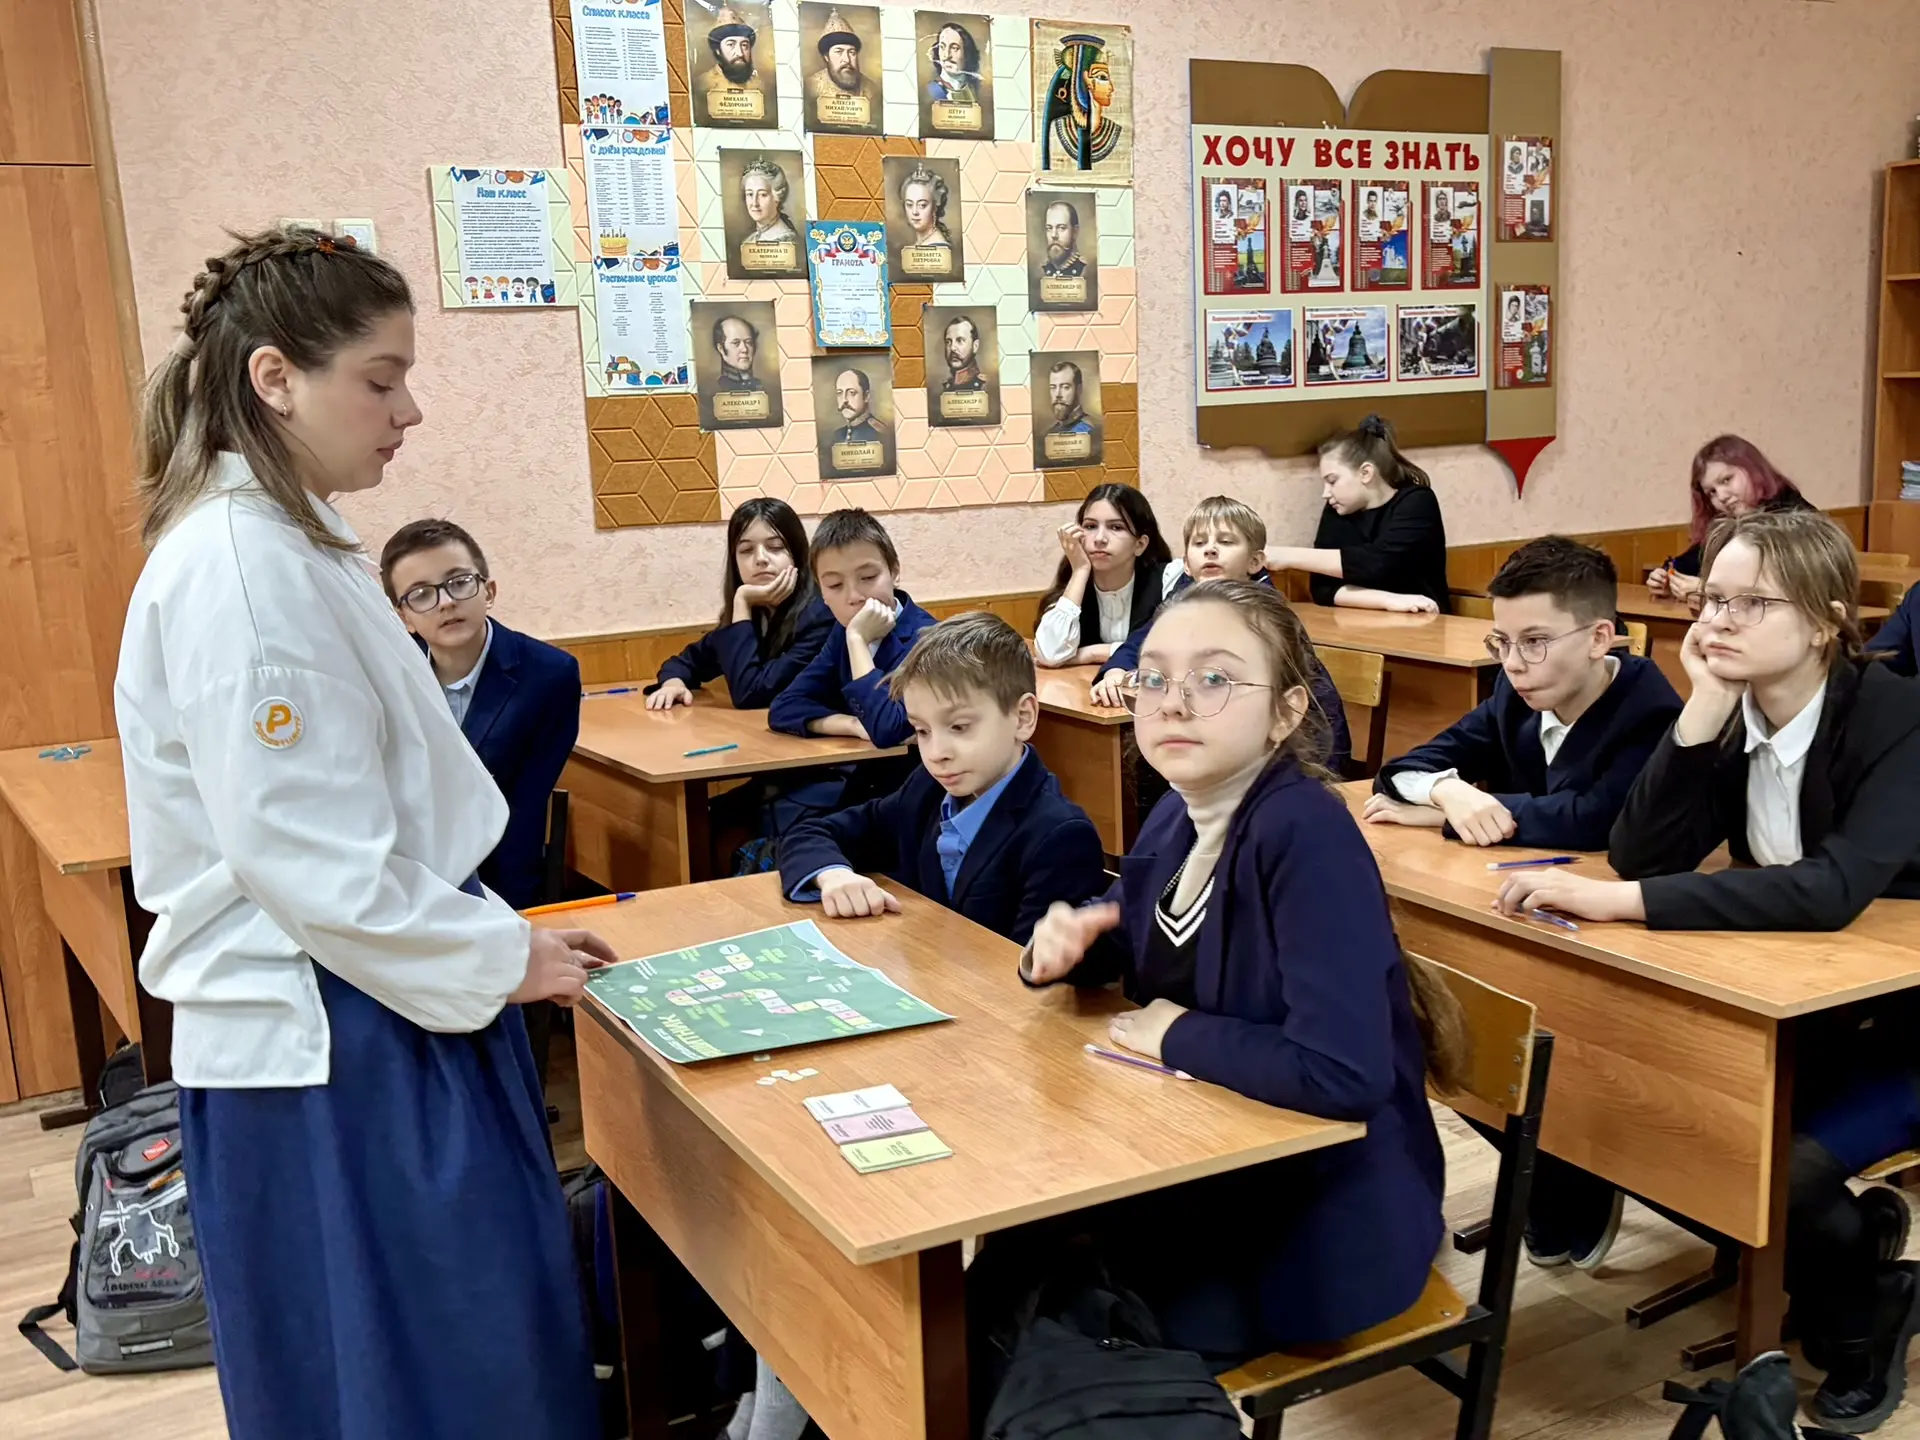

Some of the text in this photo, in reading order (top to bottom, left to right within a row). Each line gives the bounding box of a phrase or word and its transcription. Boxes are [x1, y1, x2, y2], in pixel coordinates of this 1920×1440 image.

[582, 5, 616, 18] Список
[590, 144, 597, 154] С
[1202, 135, 1480, 171] ХОЧУ ВСЕ ЗНАТЬ
[476, 187, 527, 199] Наш класс
[831, 259, 864, 267] ГРАМОТА
[647, 275, 678, 285] уроков
